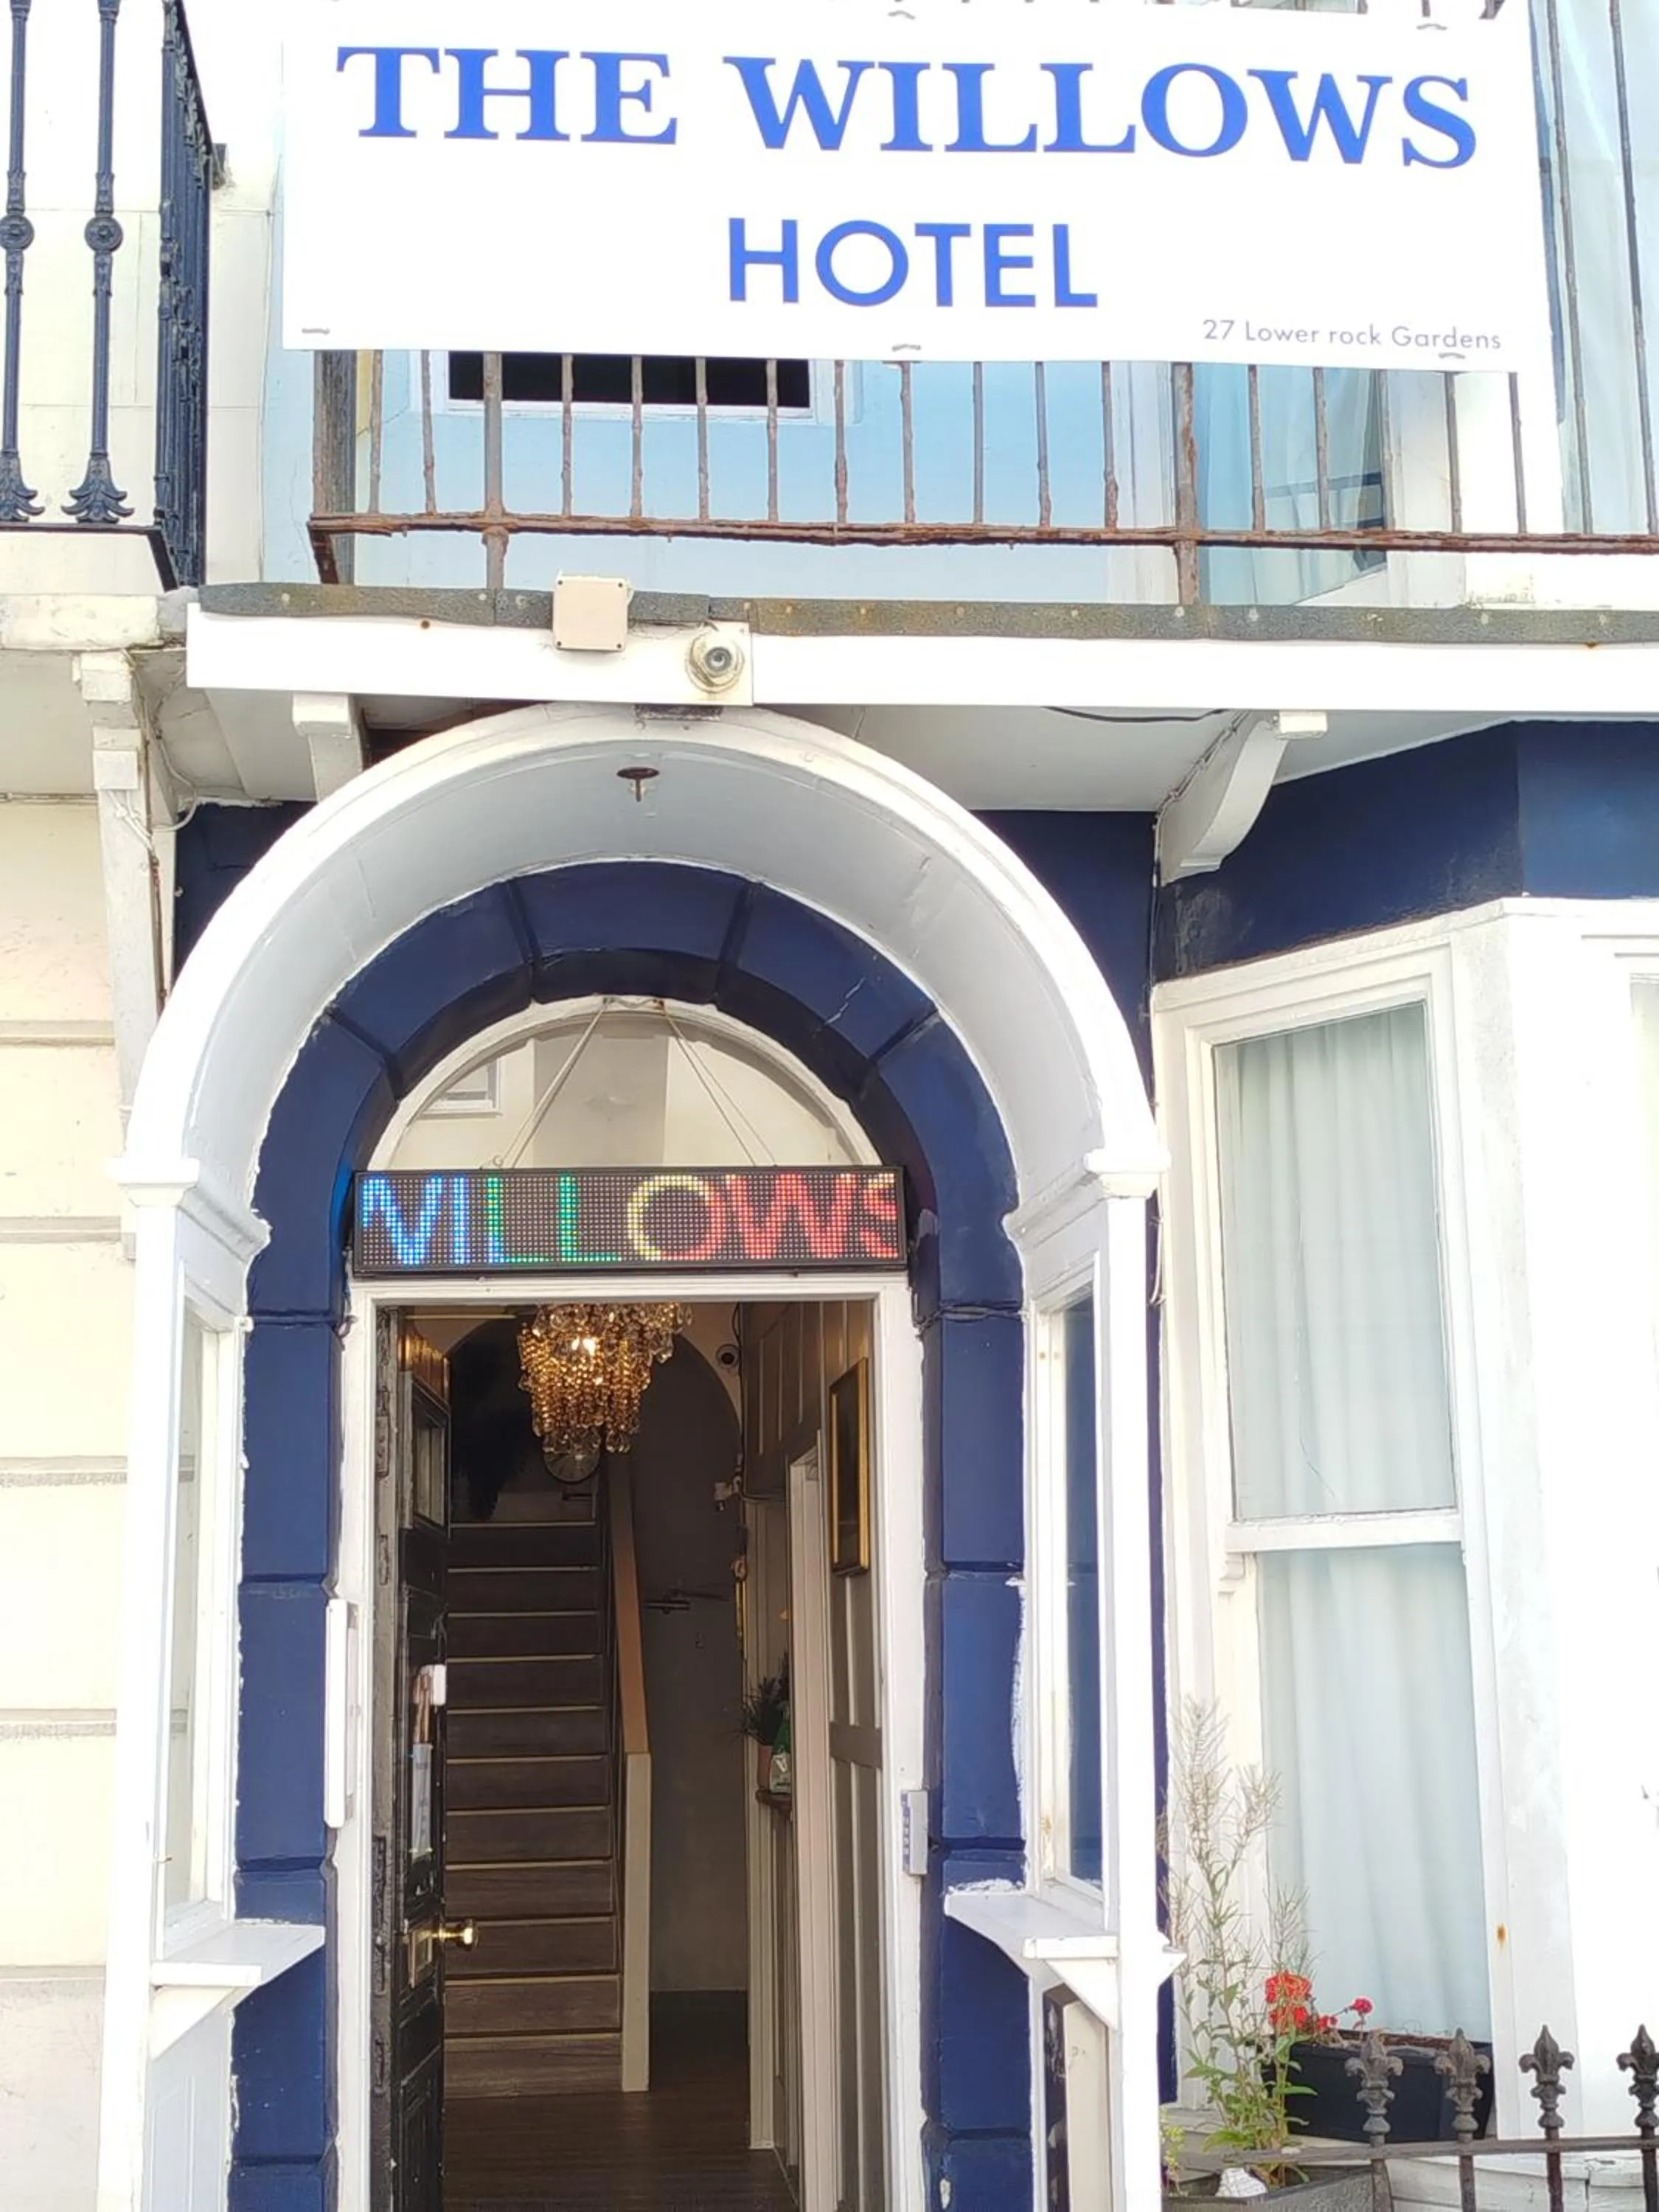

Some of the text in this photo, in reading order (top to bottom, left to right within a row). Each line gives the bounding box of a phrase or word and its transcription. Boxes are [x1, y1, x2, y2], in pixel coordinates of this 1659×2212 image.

[337, 46, 1476, 168] THE WILLOWS
[728, 218, 1098, 307] HOTEL
[1203, 319, 1502, 349] 27 Lower rock Gardens
